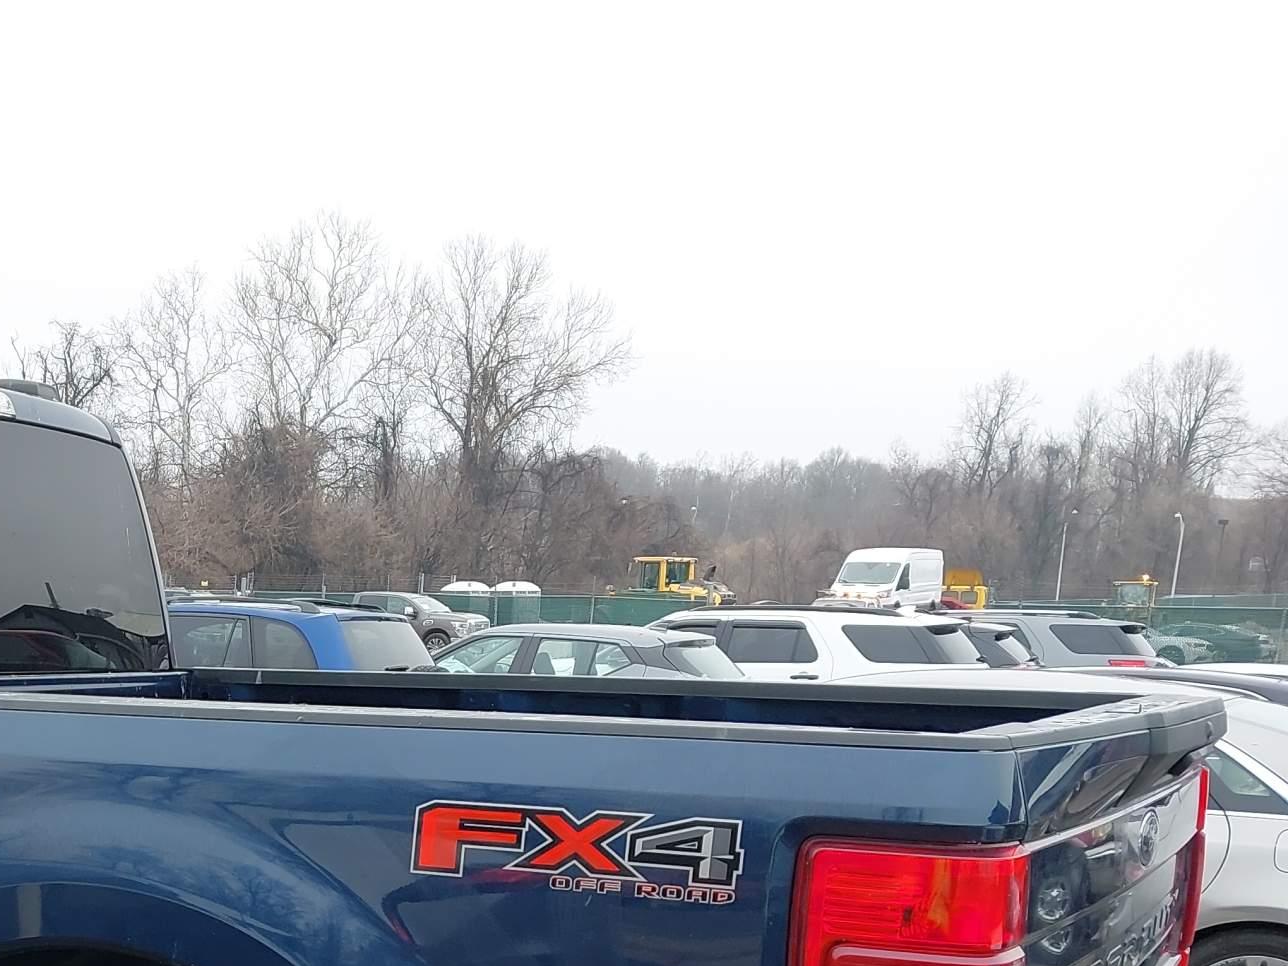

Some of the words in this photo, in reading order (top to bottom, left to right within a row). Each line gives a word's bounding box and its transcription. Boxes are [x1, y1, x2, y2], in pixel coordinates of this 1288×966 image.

[410, 799, 744, 888] FX4
[549, 875, 623, 895] OFF
[634, 881, 737, 905] ROAD
